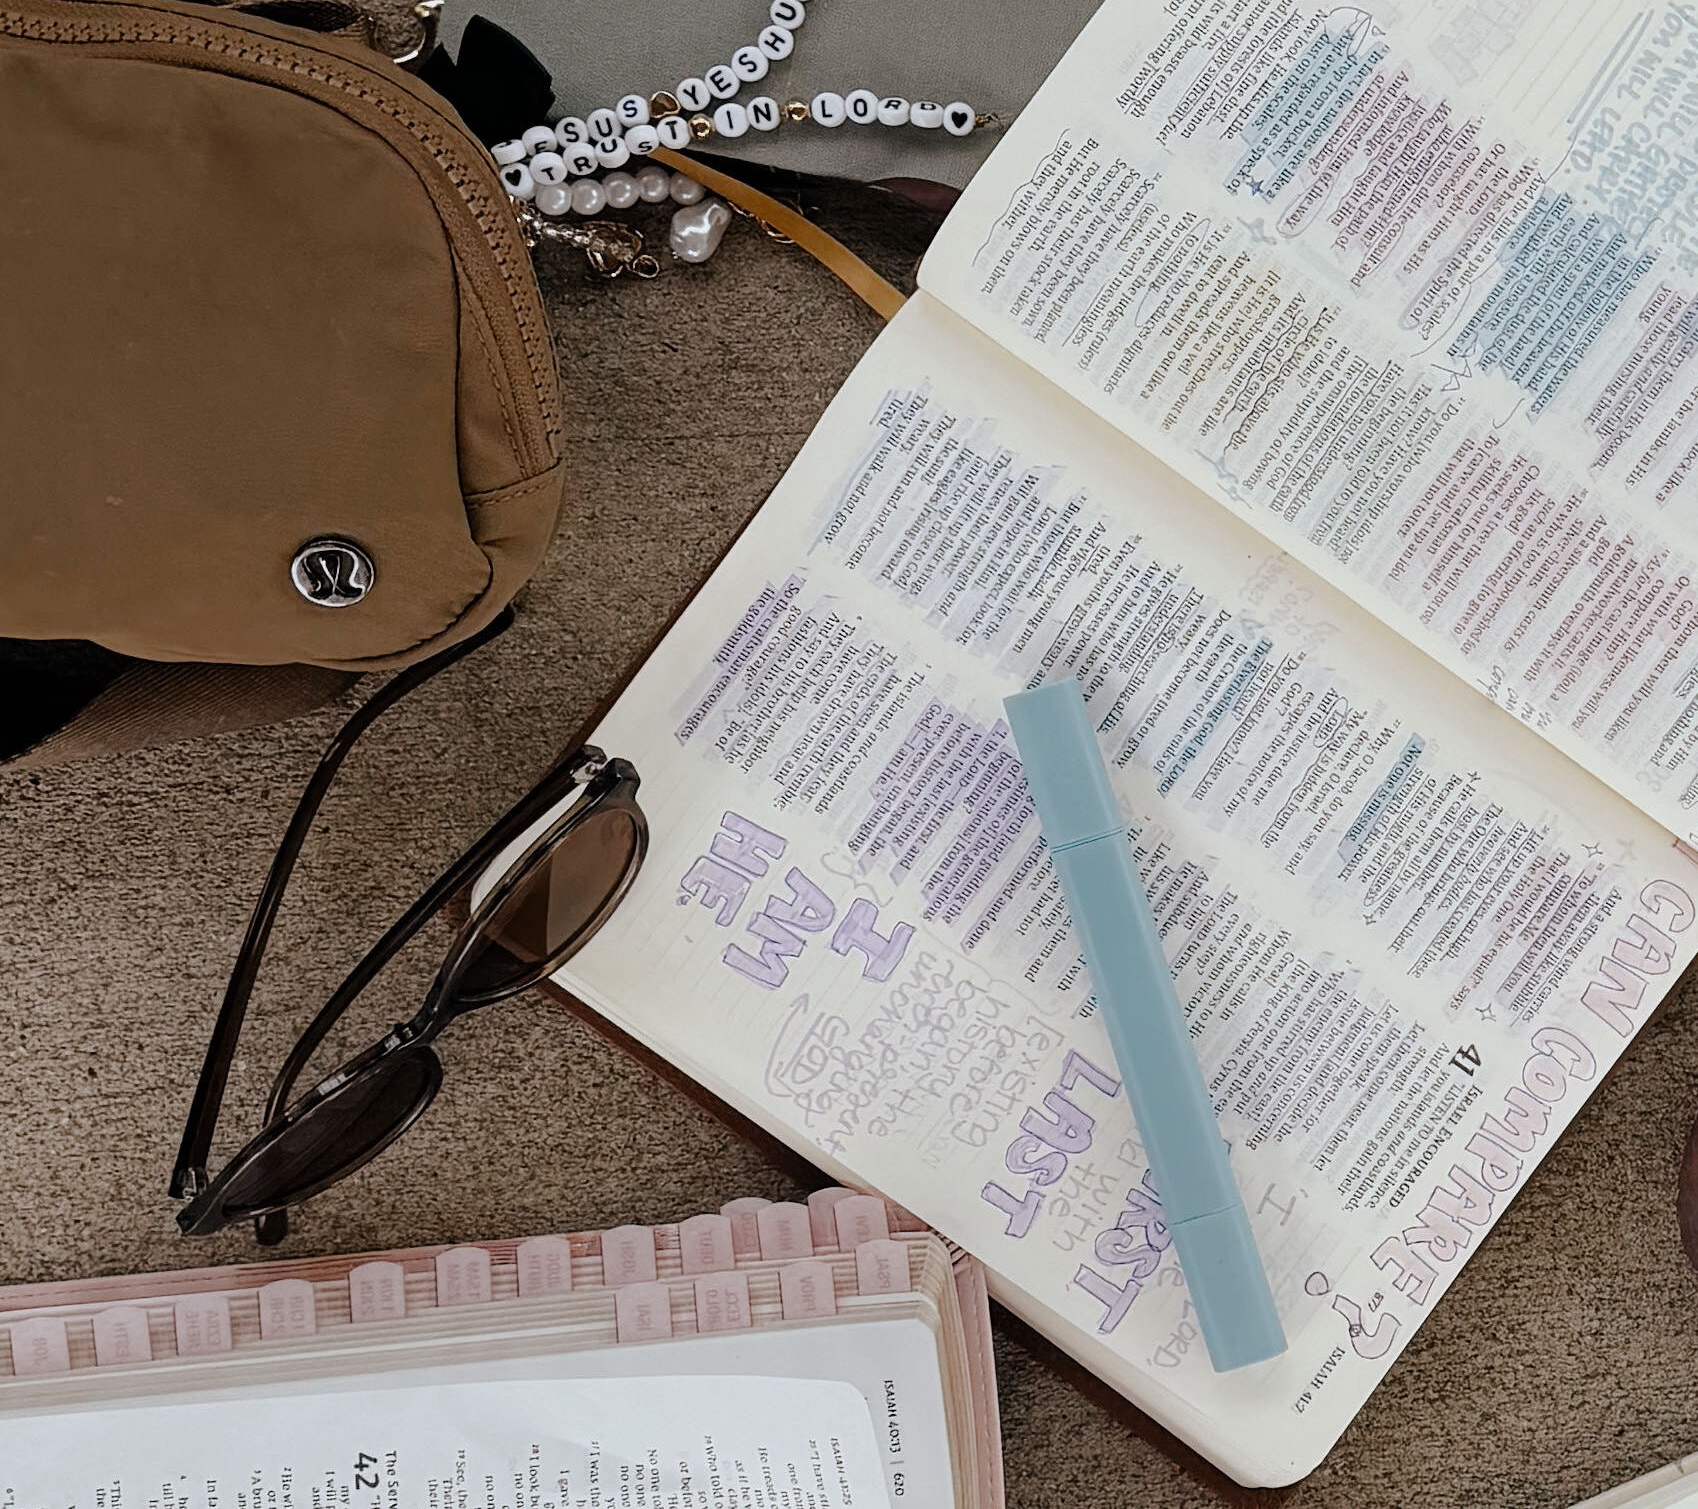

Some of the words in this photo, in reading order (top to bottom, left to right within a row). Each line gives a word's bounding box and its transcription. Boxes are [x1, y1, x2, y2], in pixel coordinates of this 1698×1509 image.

[537, 118, 684, 183] TRUST
[720, 105, 777, 133] IN
[818, 97, 938, 121] LORD
[719, 864, 837, 988] AM
[828, 896, 918, 983] I
[1578, 878, 1696, 1039] CAN
[1447, 1043, 1481, 1077] 41
[1445, 1083, 1484, 1125] ISRAEL
[979, 1048, 1131, 1239] LAST
[1388, 1125, 1453, 1208] ENCOURAGED
[1305, 1345, 1346, 1396] ISAIAH
[883, 1379, 897, 1418] ISAIAH
[829, 1437, 845, 1474] ISAIAH
[887, 1420, 901, 1453] 40:13
[352, 1451, 380, 1490] 42
[384, 1449, 397, 1476] The
[892, 1472, 905, 1496] 620
